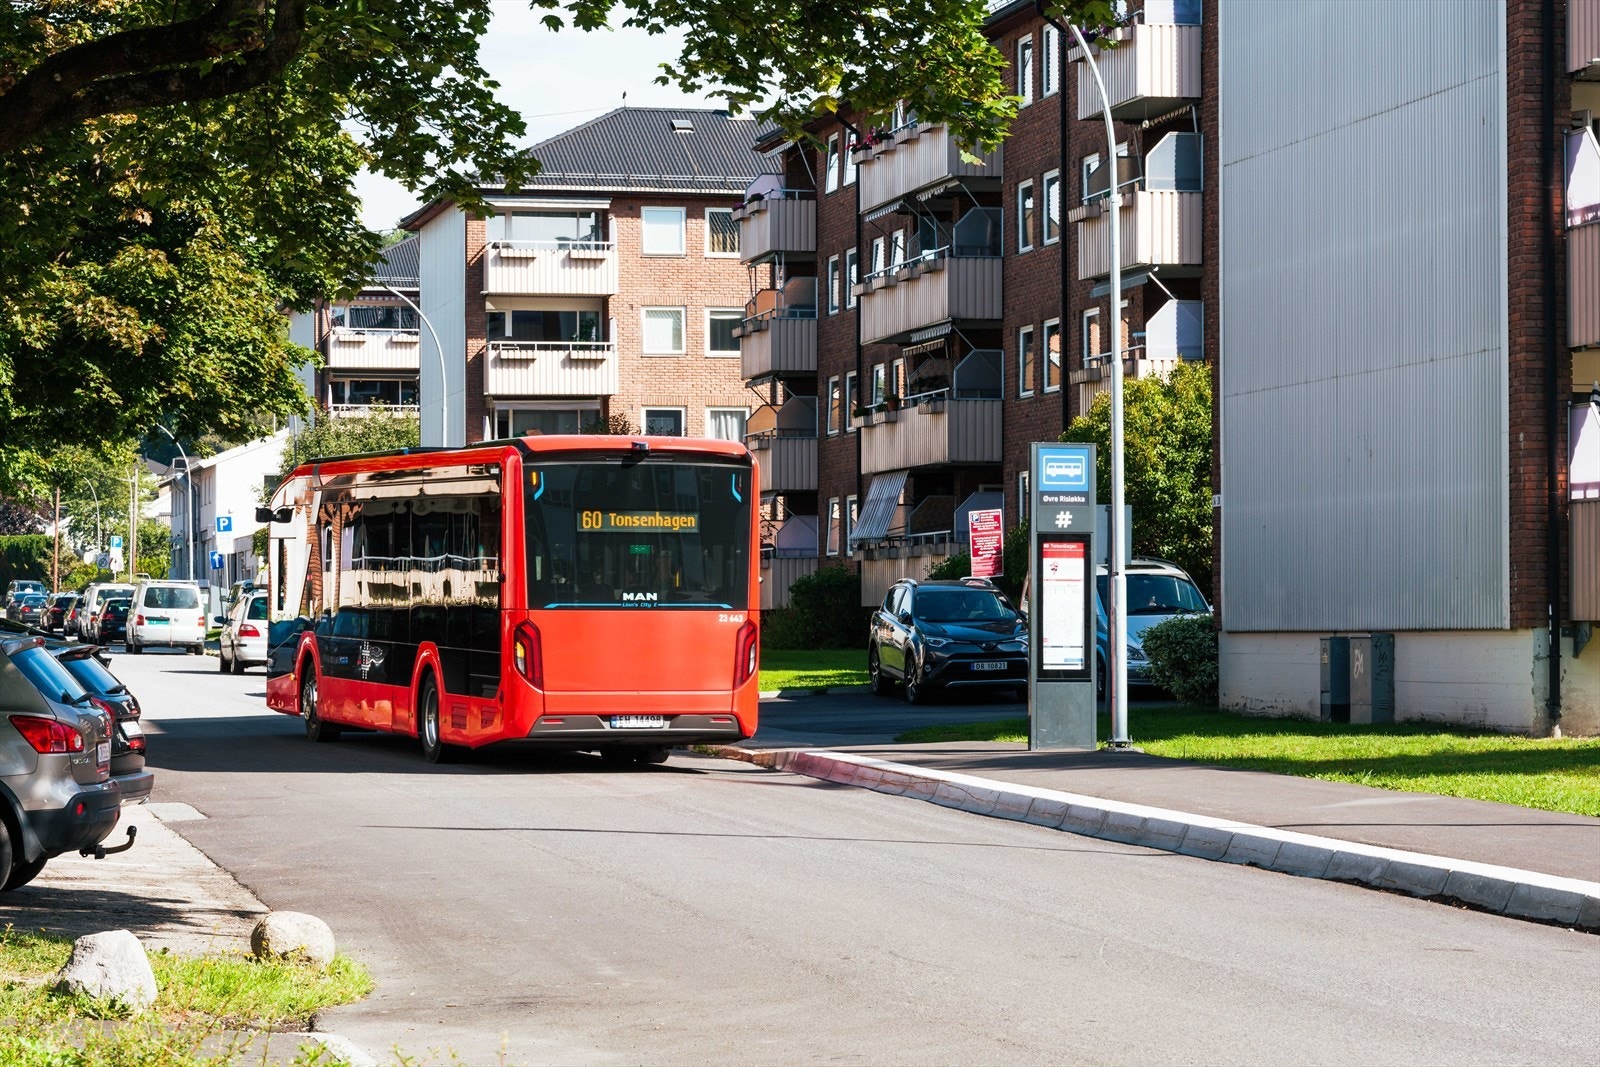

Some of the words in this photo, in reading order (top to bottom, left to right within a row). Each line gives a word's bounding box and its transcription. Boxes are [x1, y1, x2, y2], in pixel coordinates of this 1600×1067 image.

[219, 518, 229, 530] P
[582, 511, 602, 529] 60
[609, 511, 695, 530] Tonsenhagen
[622, 592, 658, 601] MAN
[718, 614, 728, 622] 23
[729, 614, 743, 622] 643
[619, 716, 630, 724] EH
